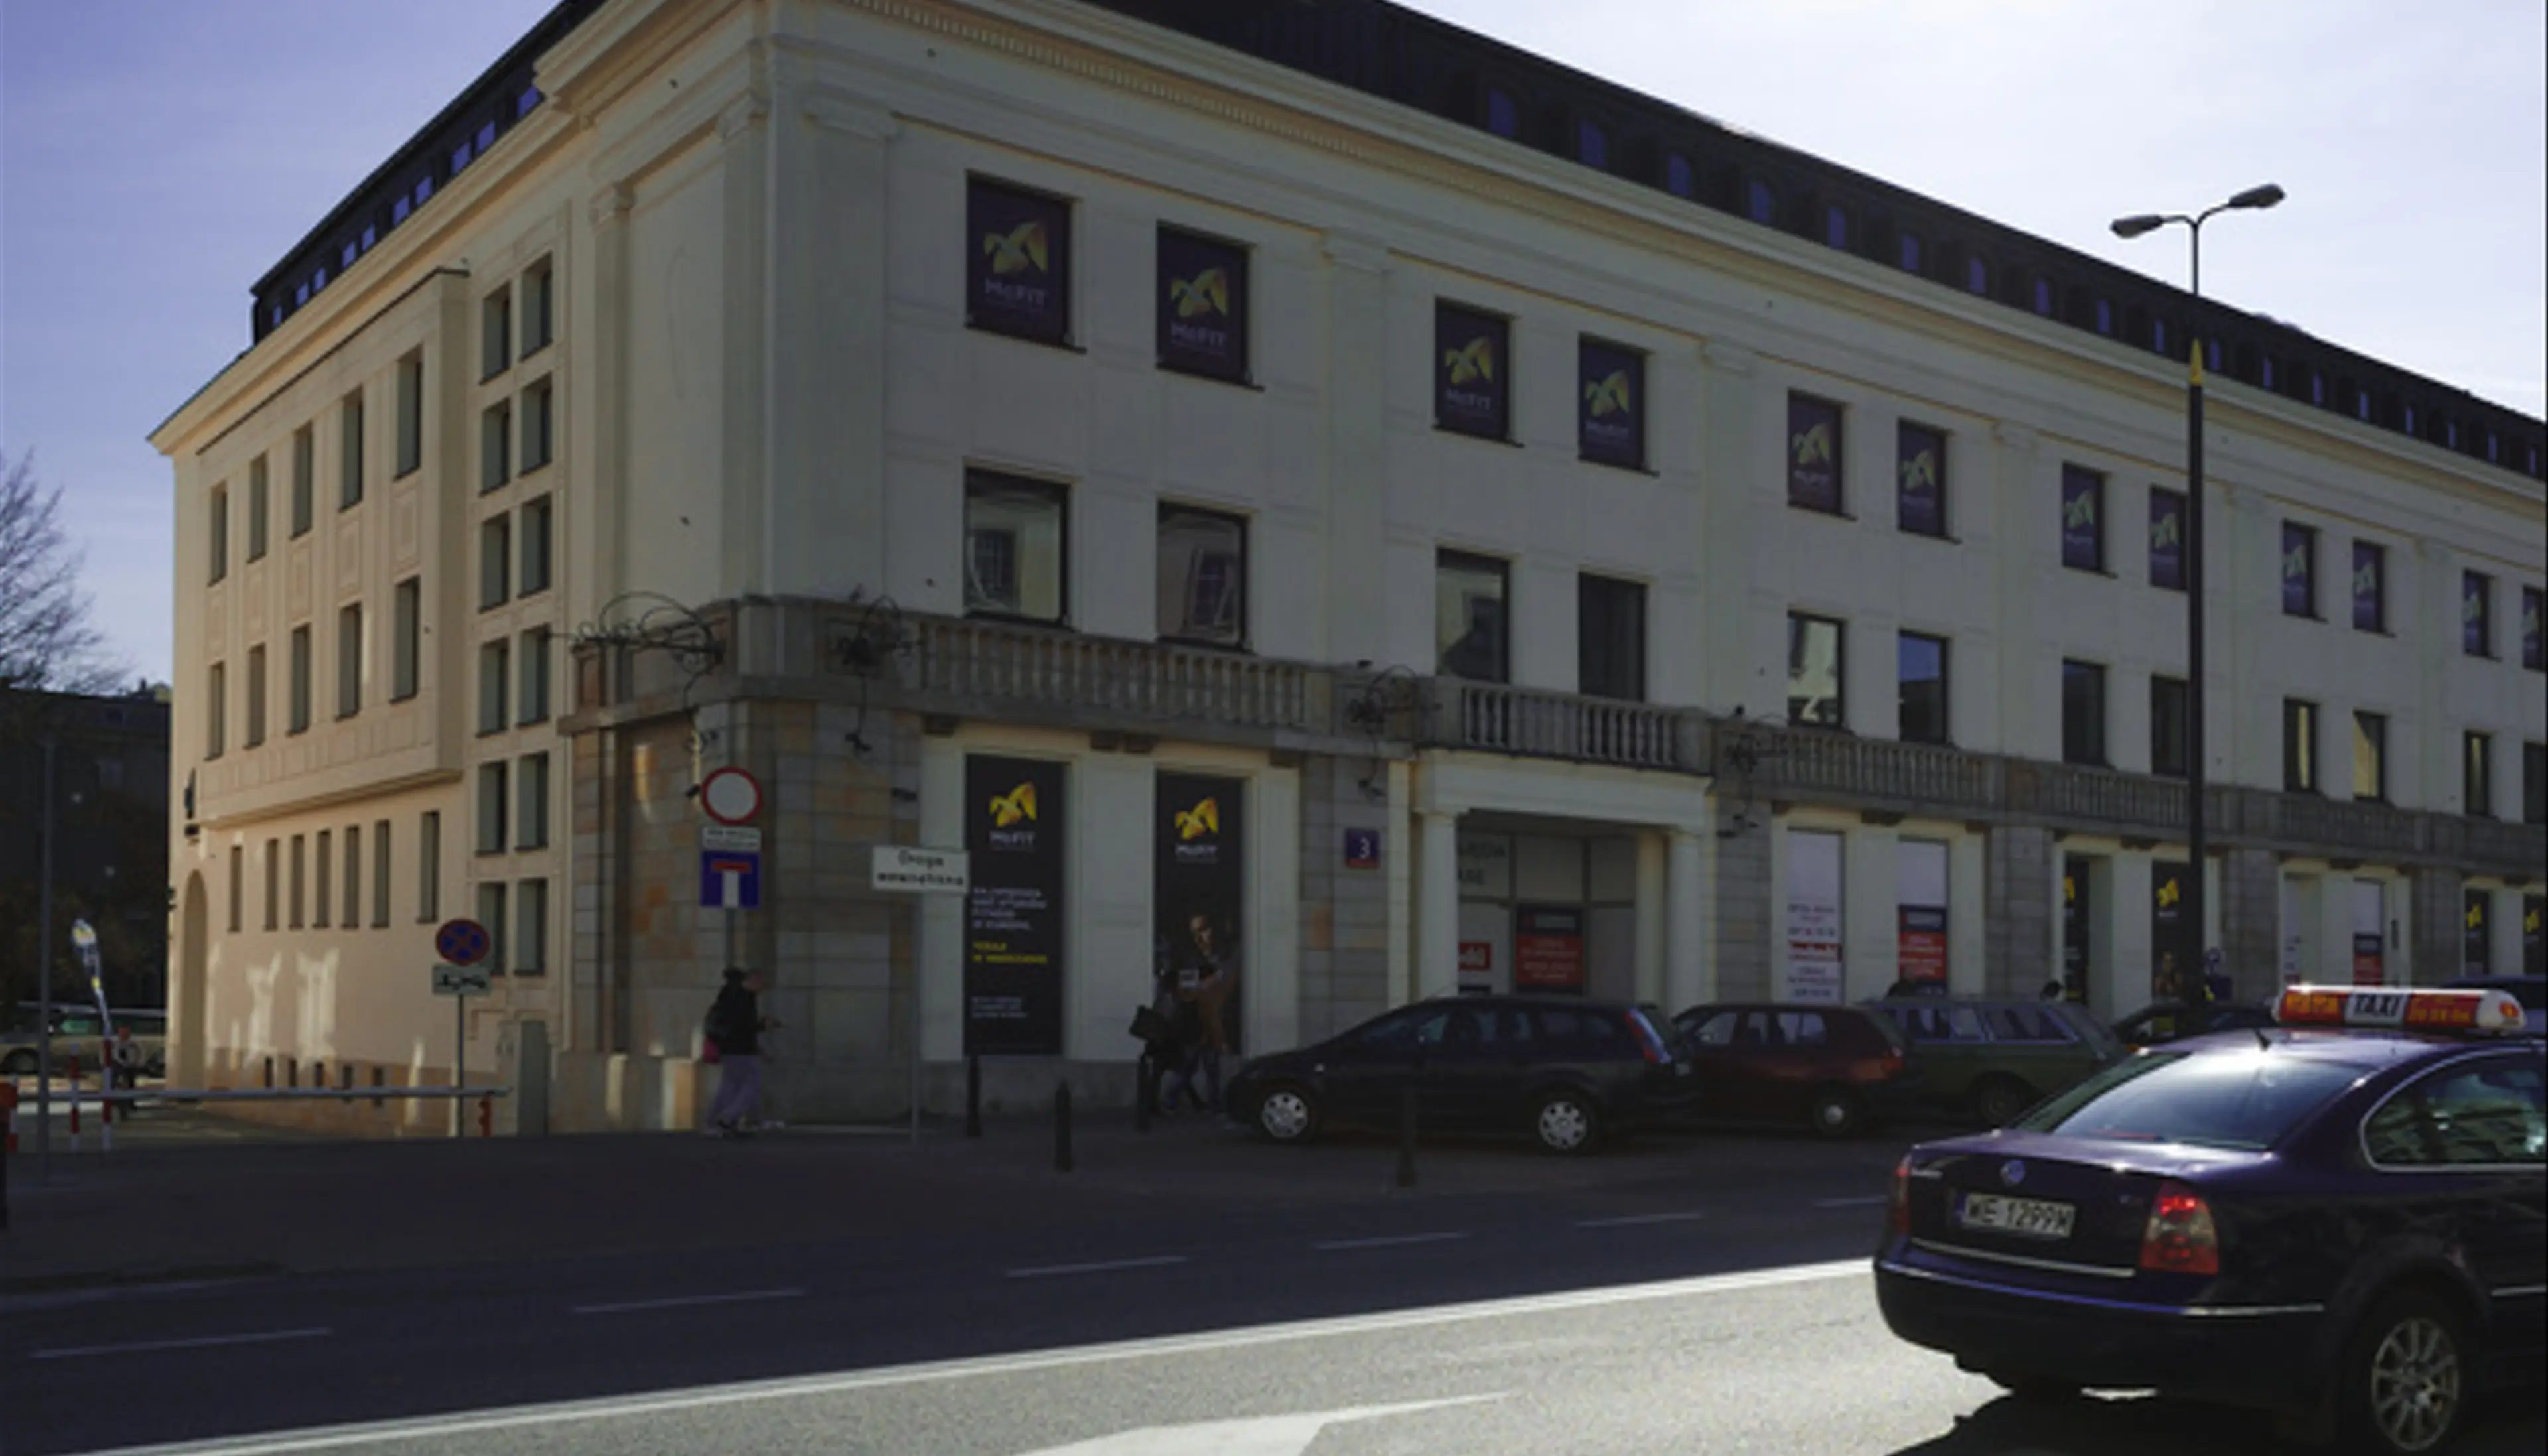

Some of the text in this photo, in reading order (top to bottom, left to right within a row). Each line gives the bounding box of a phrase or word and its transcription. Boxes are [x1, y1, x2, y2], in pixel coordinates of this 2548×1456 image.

[898, 849, 944, 869] Droga
[1359, 836, 1371, 859] 3
[2355, 993, 2403, 1016] TAXI
